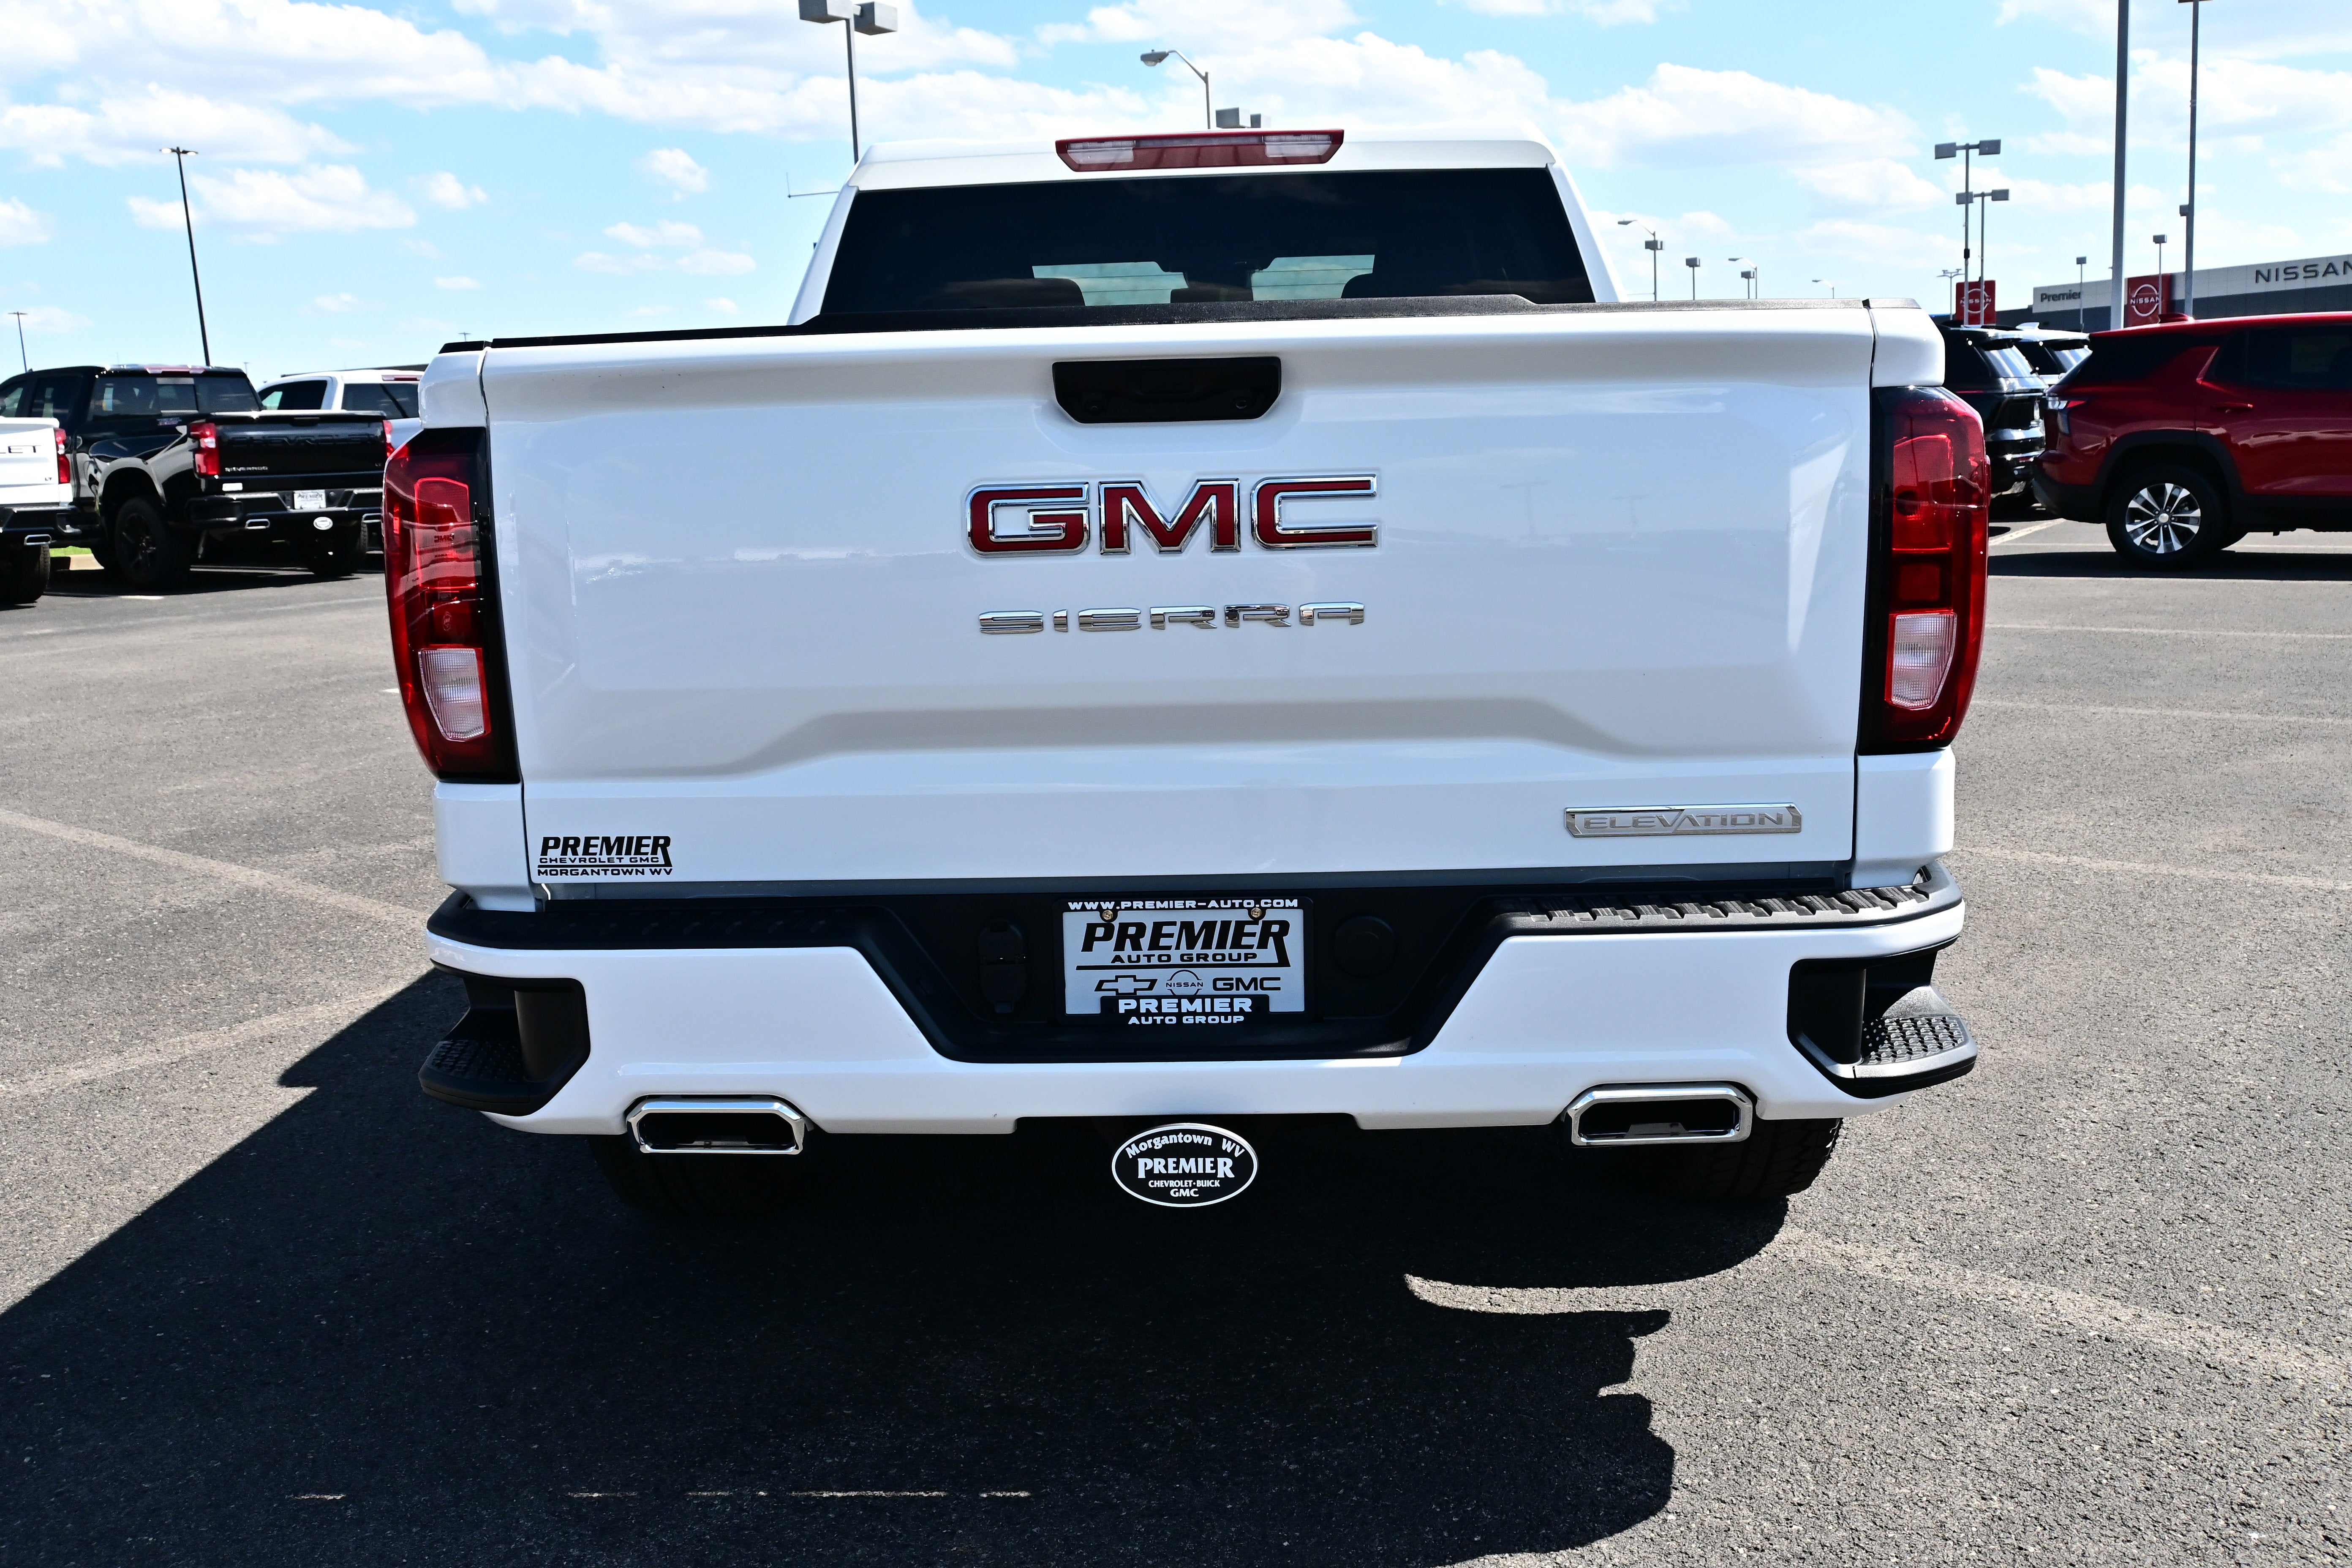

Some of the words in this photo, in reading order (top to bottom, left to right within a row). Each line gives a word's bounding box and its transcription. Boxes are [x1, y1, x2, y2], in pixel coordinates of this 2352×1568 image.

[2041, 289, 2081, 302] Premier
[966, 474, 1378, 556] GMC
[979, 601, 1365, 634] SIERRA
[1584, 812, 1783, 829] ELEVATION
[540, 836, 672, 867] PREMIER
[1068, 899, 1298, 910] WWW.PREMIER-AUTO.COM
[1081, 919, 1291, 967] PREMIER
[1111, 953, 1172, 964] AUTO
[1179, 953, 1258, 962] GROUP
[1212, 977, 1281, 991] GMC
[1119, 998, 1252, 1013] PREMIER
[1128, 1016, 1176, 1024] AUTO
[1182, 1015, 1244, 1024] GROUP
[1125, 1132, 1212, 1158] Morgantown
[1222, 1138, 1245, 1157] WV
[1138, 1157, 1235, 1178] PREMIER
[1170, 1188, 1199, 1197] GMC
